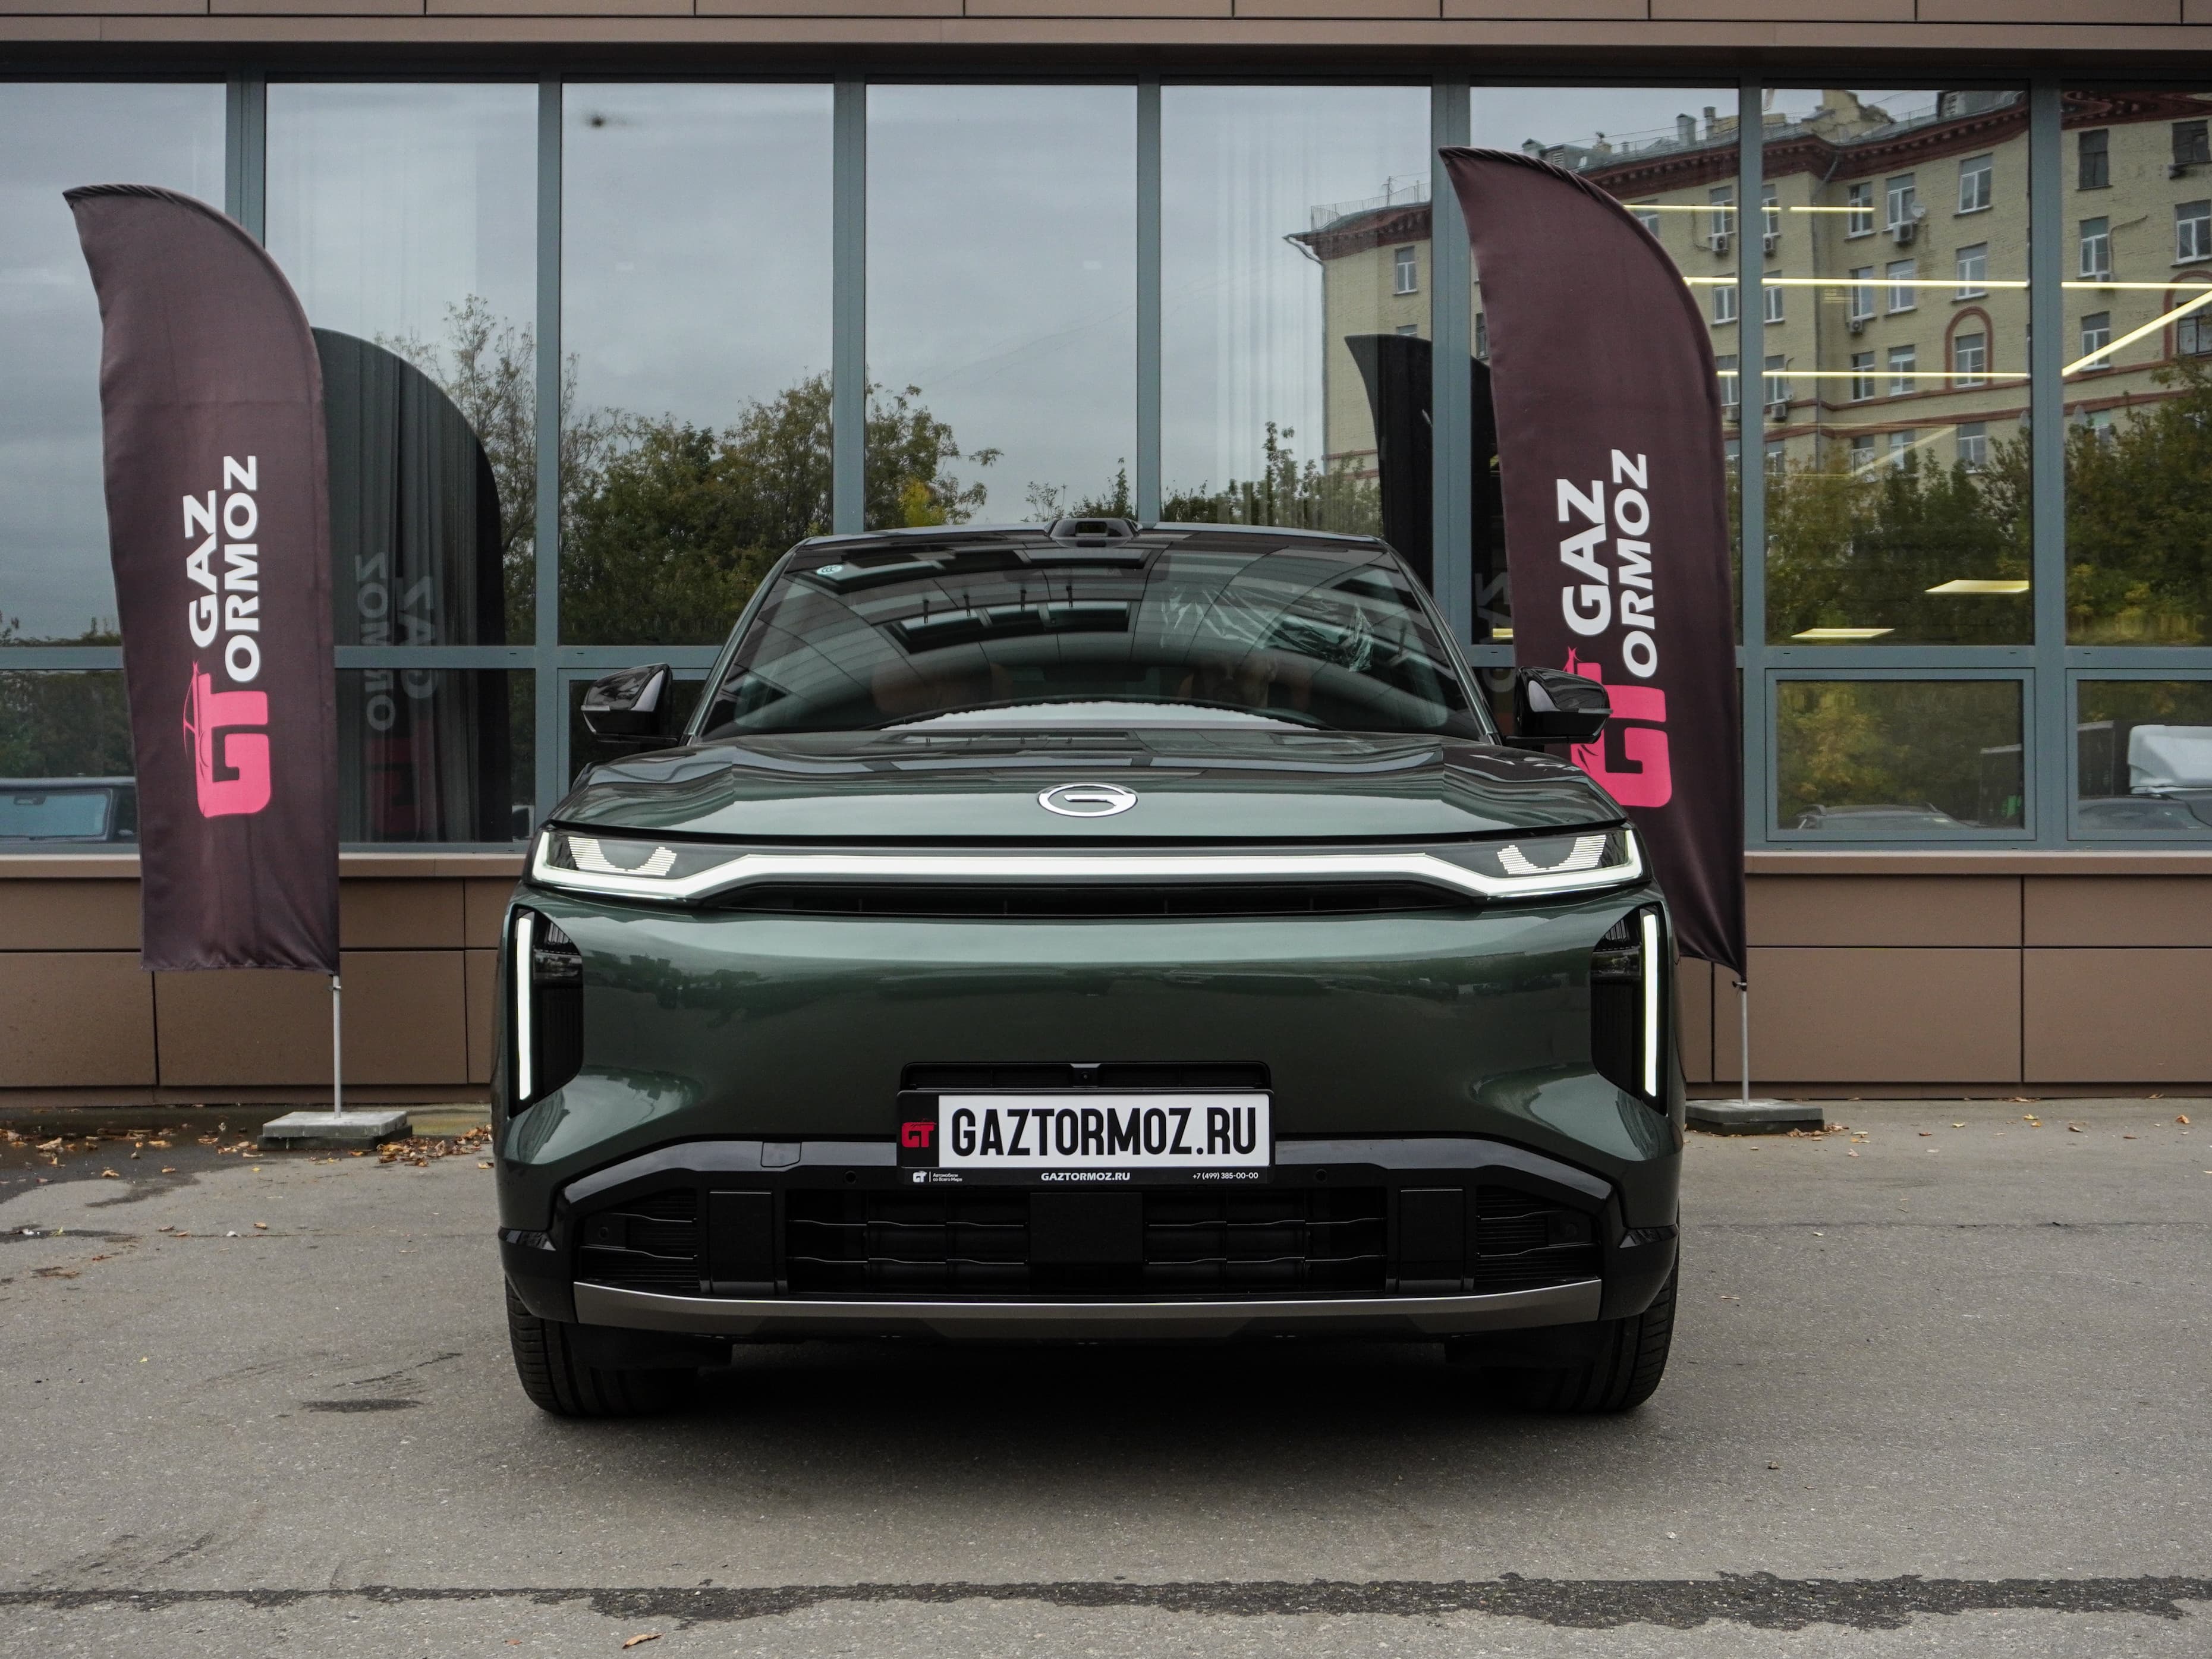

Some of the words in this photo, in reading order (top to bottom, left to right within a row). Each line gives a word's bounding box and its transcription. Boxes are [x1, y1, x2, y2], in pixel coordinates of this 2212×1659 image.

[183, 489, 219, 648] GAZ
[223, 455, 260, 682] ORMOZ
[1556, 479, 1612, 635] GAZ
[1611, 449, 1657, 678] ORMOZ
[187, 670, 270, 819] GT
[901, 1121, 936, 1148] GT
[913, 1170, 927, 1183] GT
[952, 1107, 1256, 1157] GAZTORMOZ.RU
[1040, 1172, 1131, 1181] GAZTORMOZ.RU
[1202, 1172, 1220, 1180] (499)
[1220, 1172, 1259, 1180] 385-00-00
